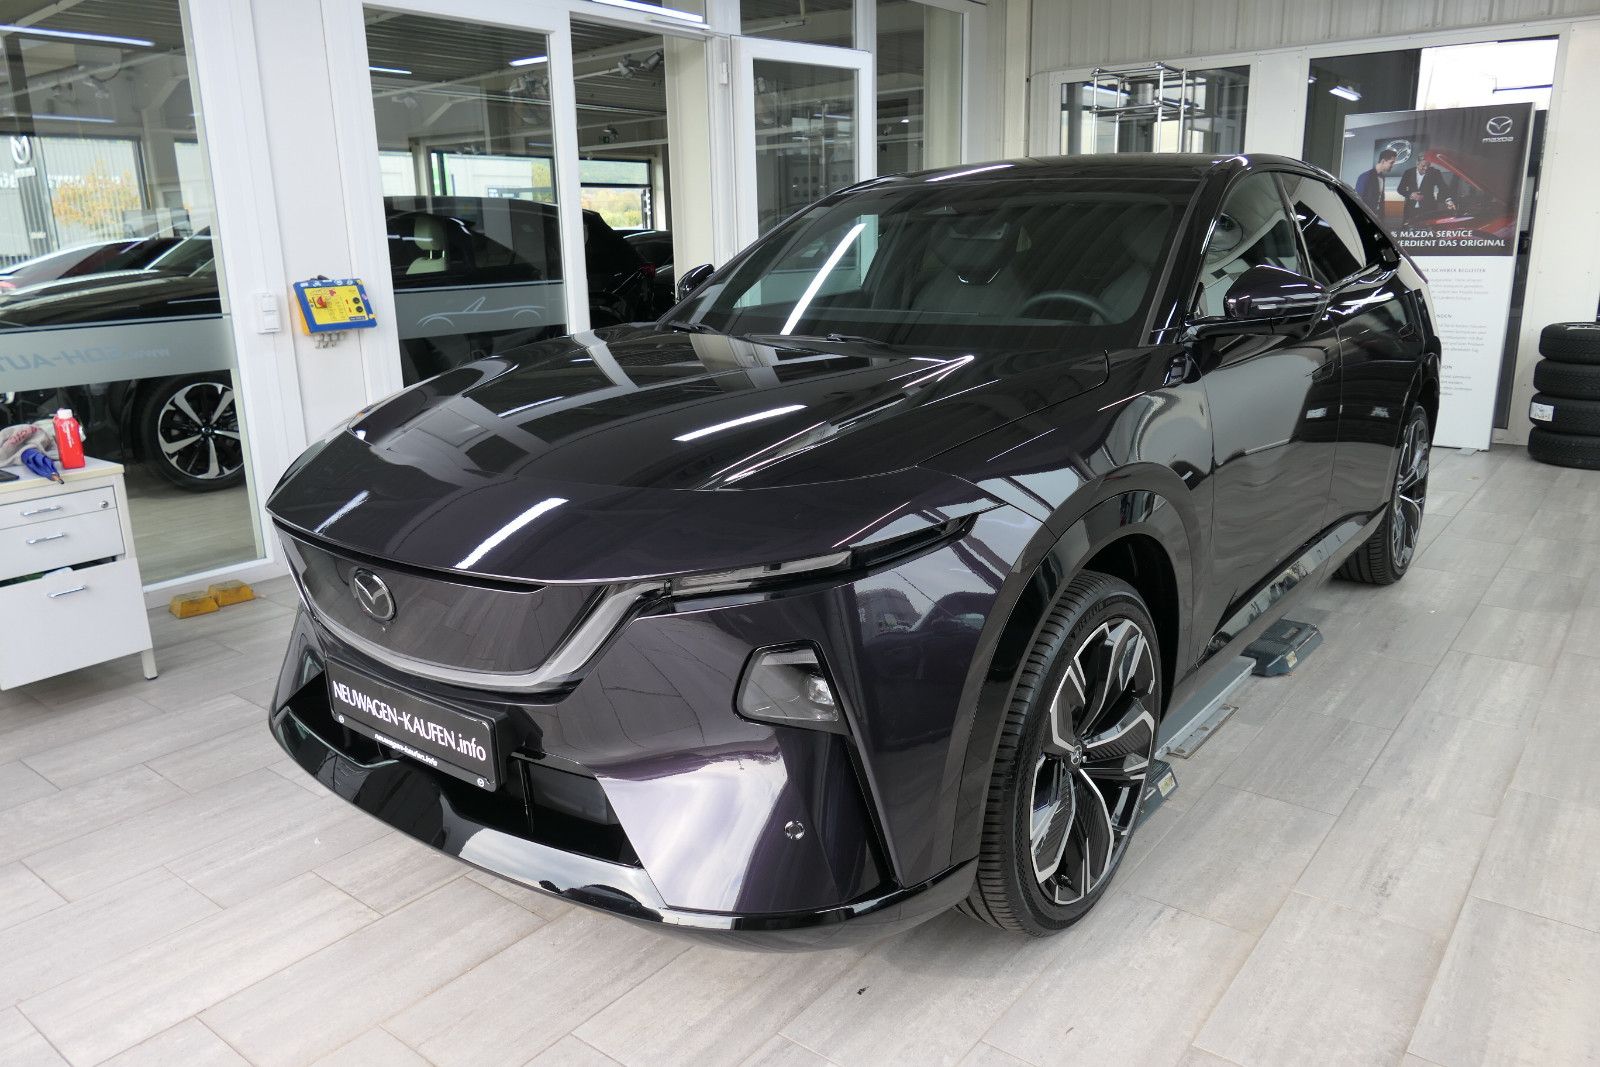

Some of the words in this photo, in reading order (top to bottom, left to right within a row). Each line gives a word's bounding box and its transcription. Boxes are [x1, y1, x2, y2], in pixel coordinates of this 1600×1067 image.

[1436, 229, 1473, 238] SERVICE
[1439, 239, 1458, 247] DAS
[1459, 238, 1506, 247] ORIGINAL
[332, 680, 487, 762] NEUWAGEN-KAUFEN.info
